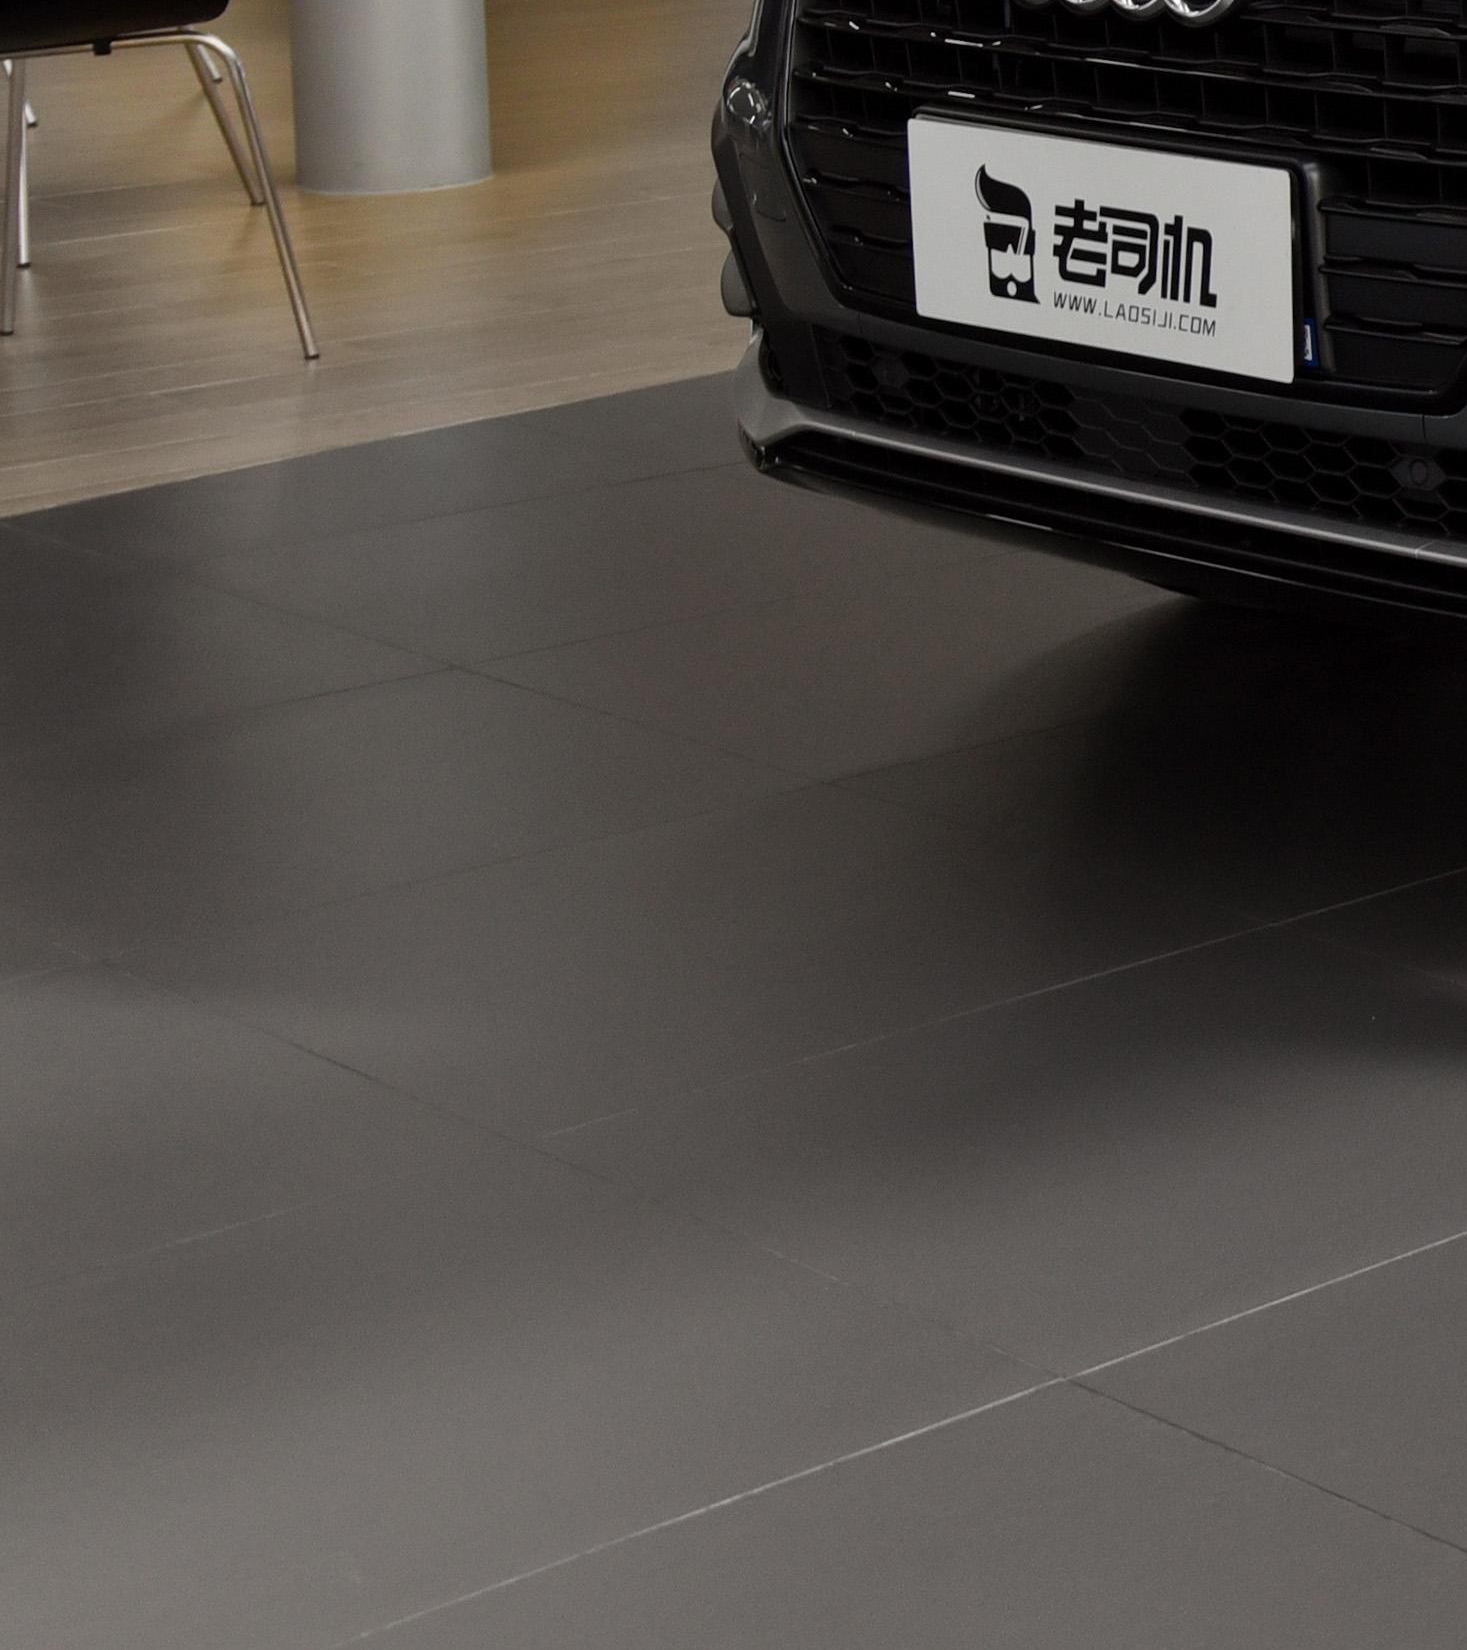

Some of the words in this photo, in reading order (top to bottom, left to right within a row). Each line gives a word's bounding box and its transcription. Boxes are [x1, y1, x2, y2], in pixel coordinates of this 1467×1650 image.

[1052, 198, 1218, 309] 老司机
[1053, 291, 1217, 337] WWW.LAOSIJI.COM
